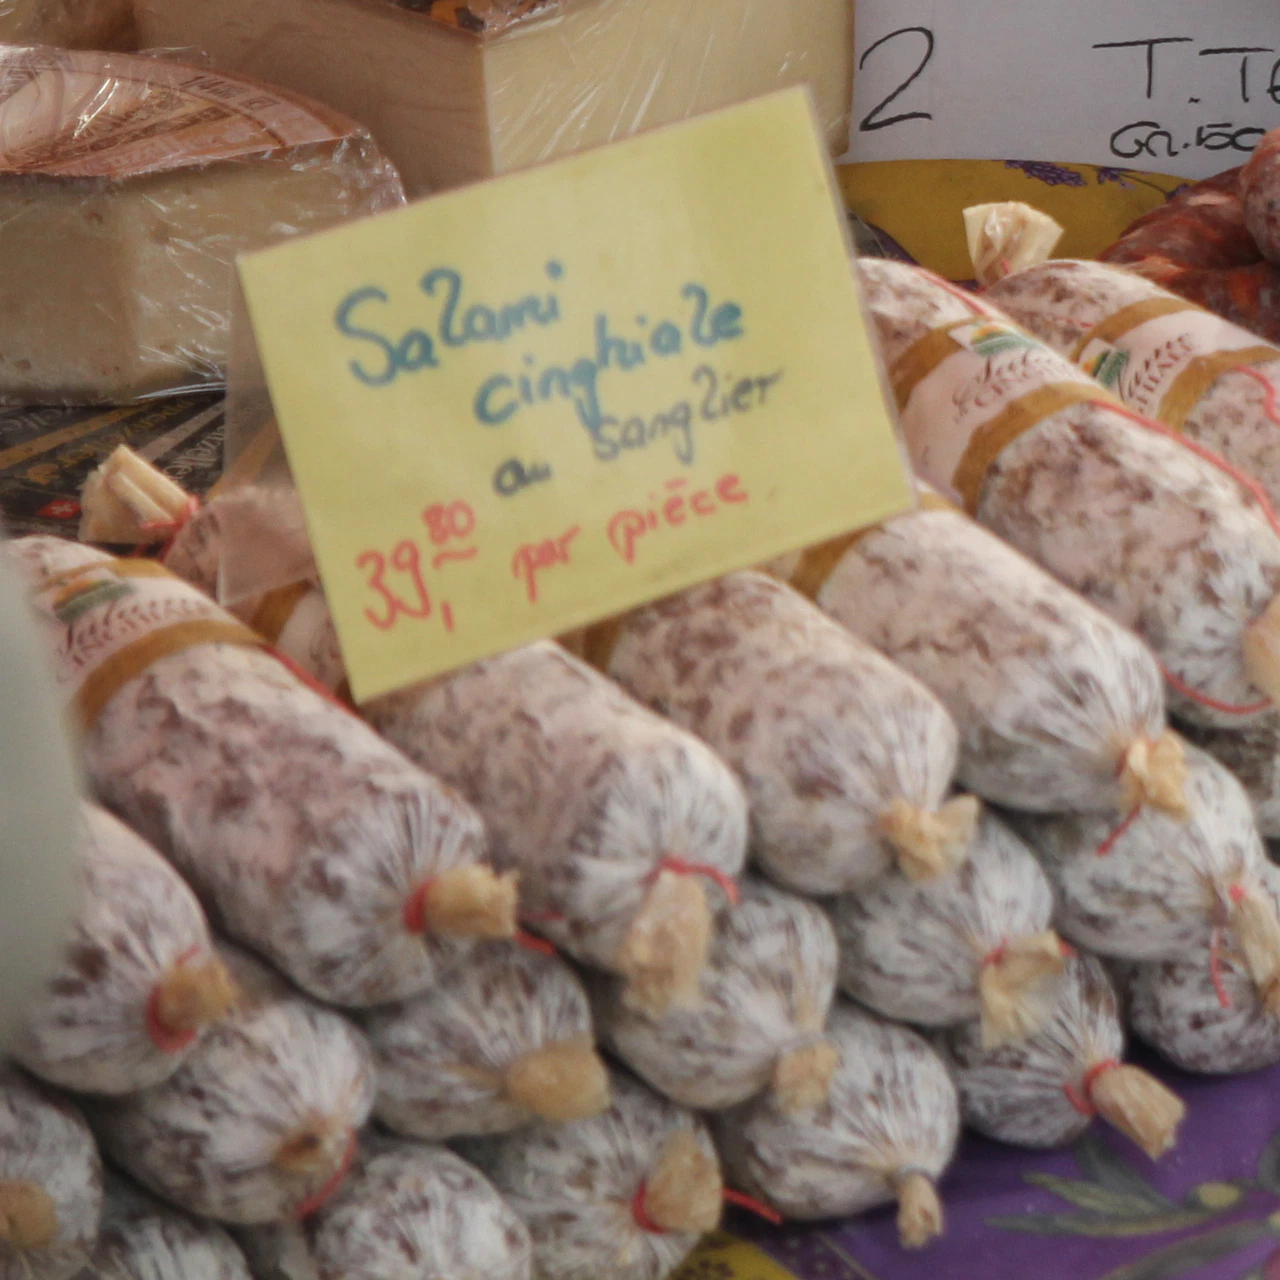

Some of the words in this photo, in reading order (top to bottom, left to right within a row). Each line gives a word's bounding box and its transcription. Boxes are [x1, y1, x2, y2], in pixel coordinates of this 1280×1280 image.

[860, 27, 934, 132] 2
[335, 258, 565, 388] Salami
[473, 283, 745, 440] cinghiale
[492, 457, 554, 498] au
[592, 363, 785, 468] sanglier
[512, 524, 582, 606] par
